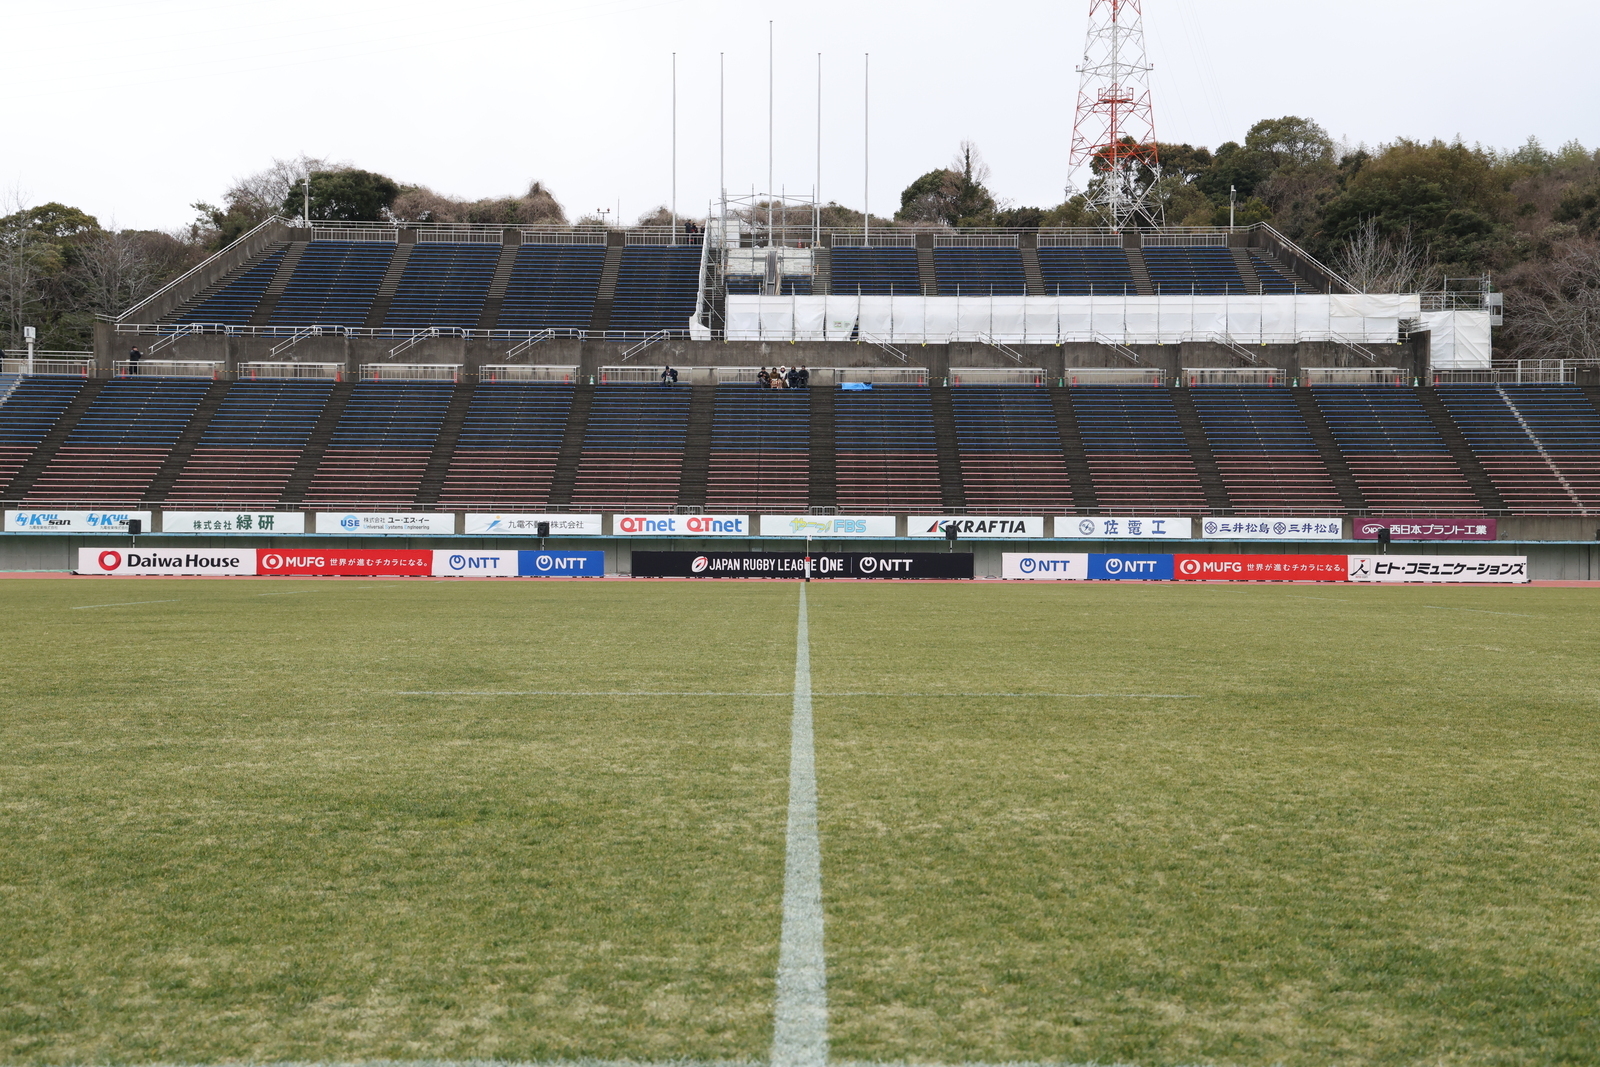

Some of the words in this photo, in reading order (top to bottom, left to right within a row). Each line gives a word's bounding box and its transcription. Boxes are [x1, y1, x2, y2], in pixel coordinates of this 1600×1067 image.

[193, 520, 232, 530] 株式会社
[236, 514, 275, 531] 緑研
[340, 519, 360, 527] USE
[620, 517, 676, 532] QTnet
[686, 517, 743, 532] QTnet
[834, 519, 867, 533] FBS
[1104, 519, 1166, 535] 佐電工
[1219, 522, 1270, 533] 三井松島
[1288, 523, 1340, 535] 三井松島
[1389, 524, 1487, 535] 西日本プラント工業
[127, 553, 182, 568] Daiwa
[185, 554, 240, 568] House
[285, 556, 325, 568] MUFG
[330, 557, 428, 567] 世界が進むチカラになる。
[468, 557, 500, 569] NTT
[555, 557, 587, 569] NTT
[709, 558, 741, 571] JAPAN
[743, 558, 776, 571] RUGBY
[879, 559, 914, 571] NTT
[1038, 560, 1070, 572] NTT
[1125, 560, 1157, 573] NTT
[1203, 561, 1242, 573] MUFG
[1247, 563, 1345, 572] 世界が進むチカラになる。
[1374, 562, 1526, 575] ヒト・コミュニケーションズ
